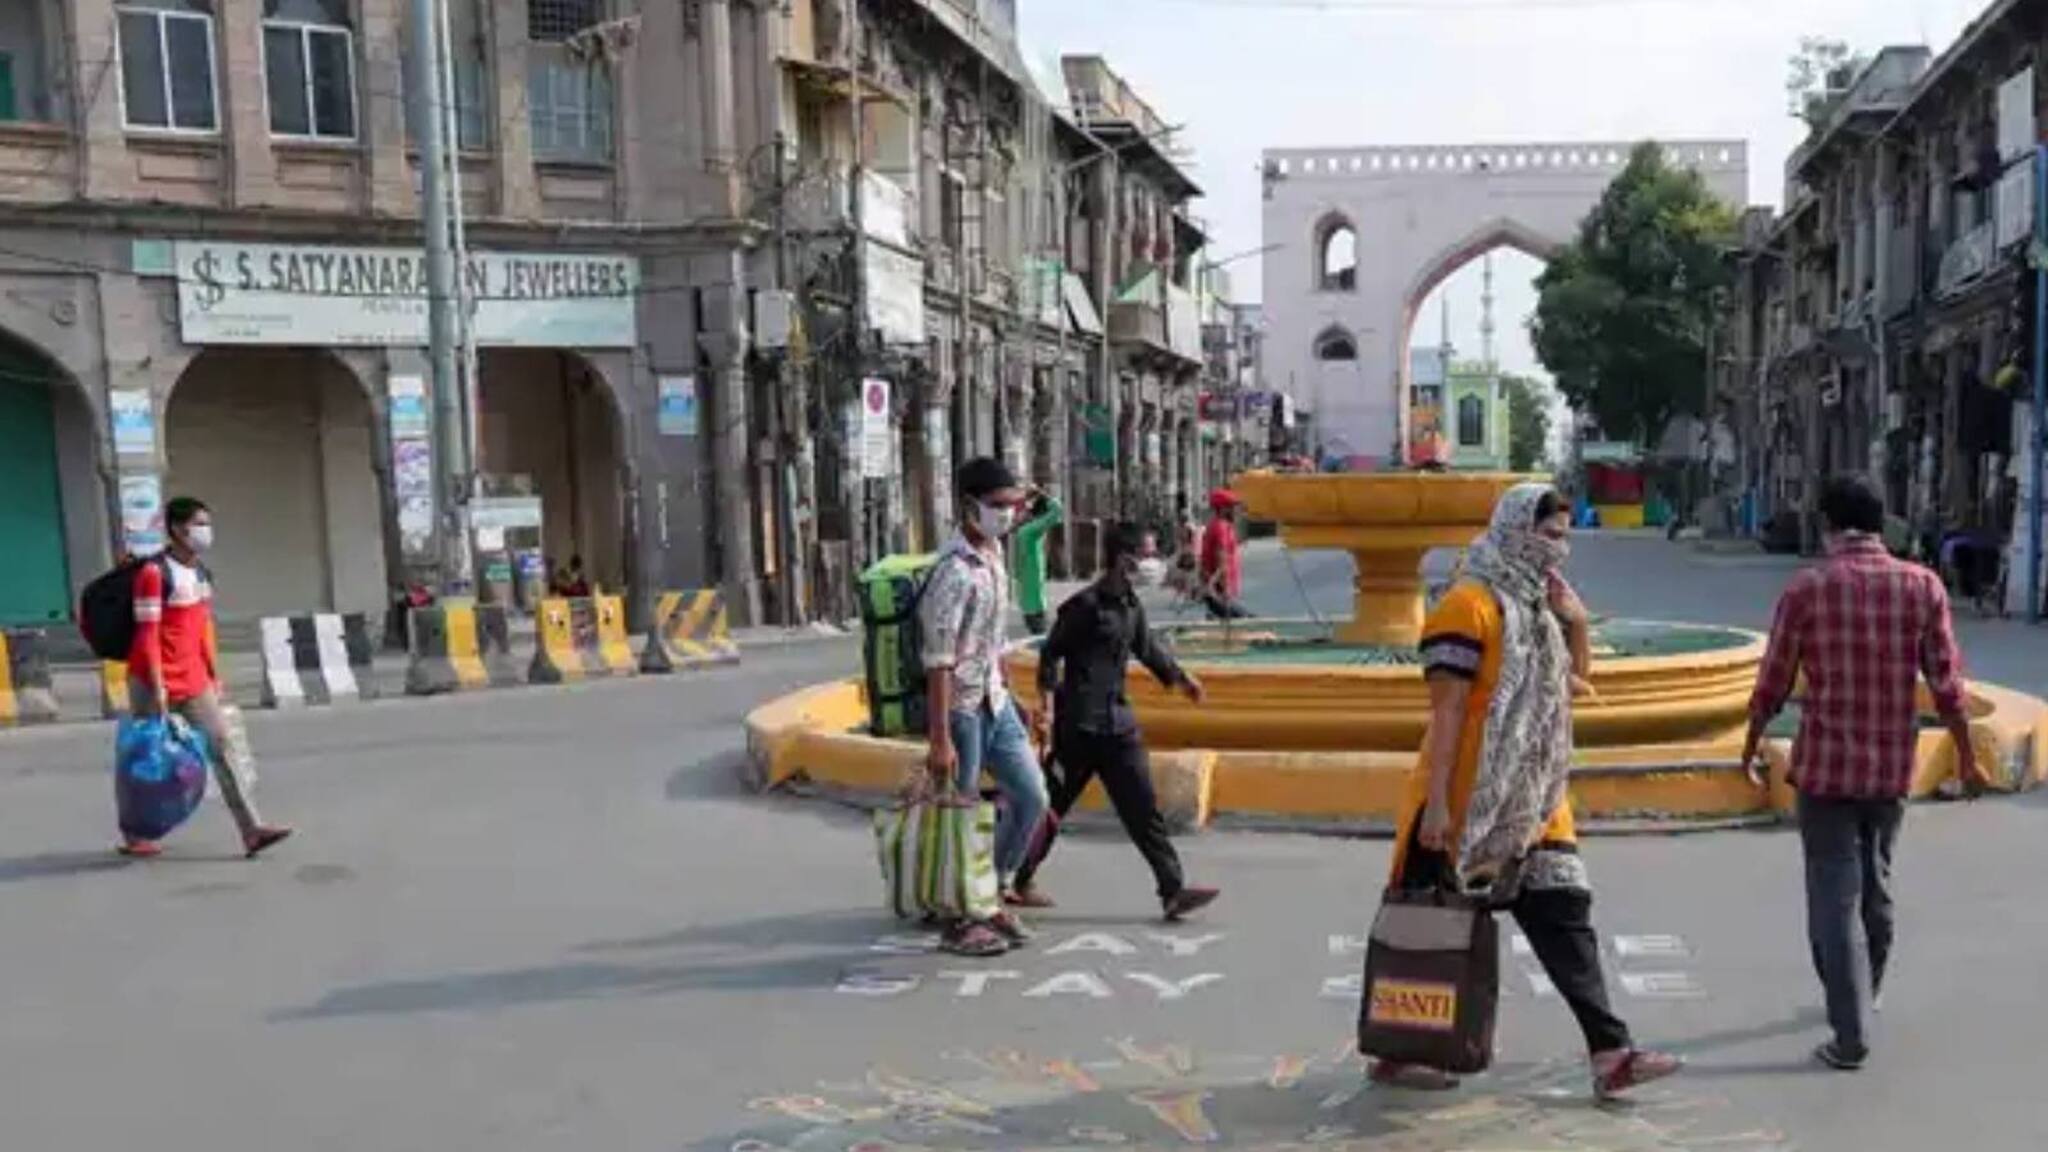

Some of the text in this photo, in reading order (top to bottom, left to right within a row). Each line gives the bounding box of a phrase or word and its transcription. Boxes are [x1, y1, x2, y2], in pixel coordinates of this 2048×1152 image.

[236, 251, 262, 291] S.
[268, 252, 488, 297] SATYANARAN
[503, 258, 629, 298] JEWELLERS
[869, 932, 1228, 956] SAY
[834, 970, 1226, 998] STAY
